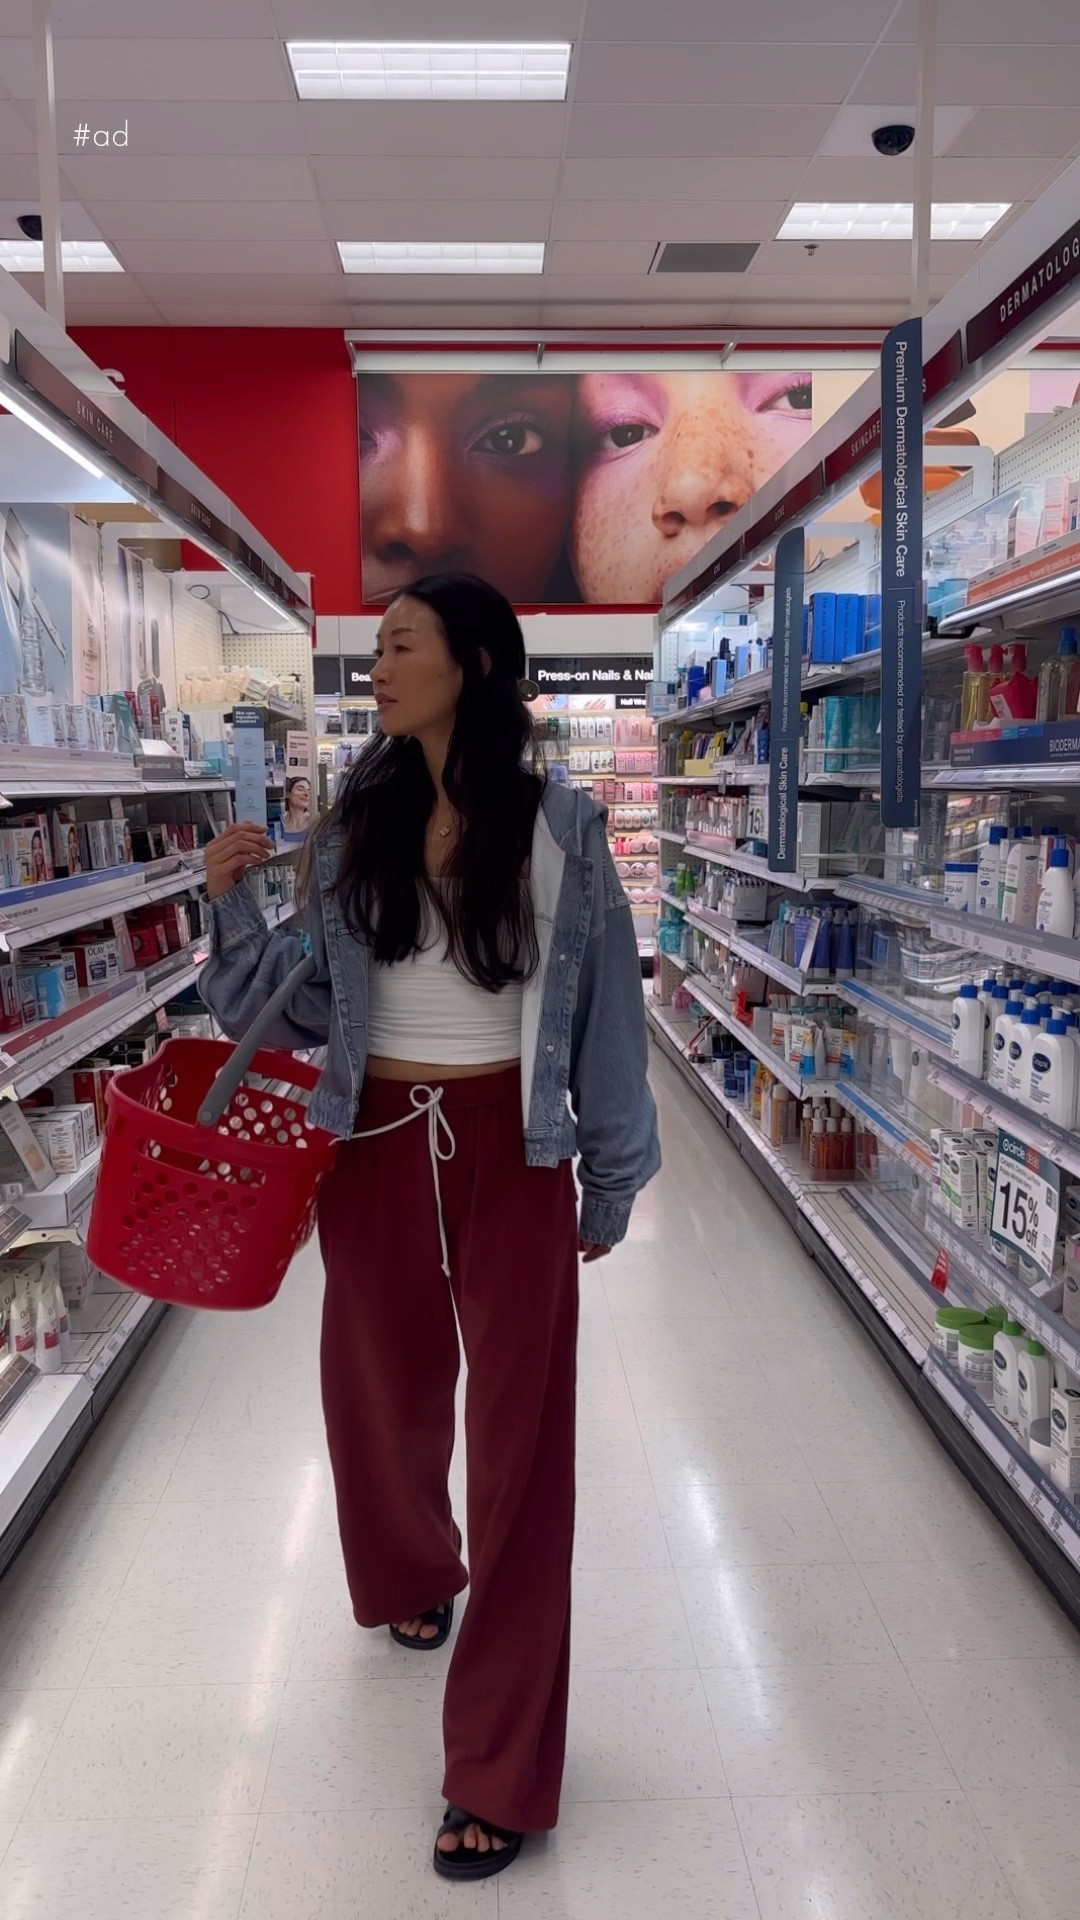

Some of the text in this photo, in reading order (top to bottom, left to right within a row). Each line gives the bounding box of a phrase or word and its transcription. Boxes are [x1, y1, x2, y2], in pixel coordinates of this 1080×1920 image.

[76, 400, 113, 444] SKIN CARE
[850, 420, 881, 457] SKINCARE
[894, 341, 908, 577] Premium Dermatological Skin Care
[774, 504, 785, 523] ACNE
[537, 669, 590, 681] Press-on
[592, 669, 621, 681] Nails
[623, 669, 632, 681] &
[895, 600, 906, 803] Products recommended or tested by dermatologists
[1049, 738, 1080, 753] BIODERMA
[777, 747, 789, 860] Dermatological Skin Care
[87, 945, 105, 957] OLAY
[1009, 1141, 1026, 1161] circle
[1025, 1229, 1038, 1249] off
